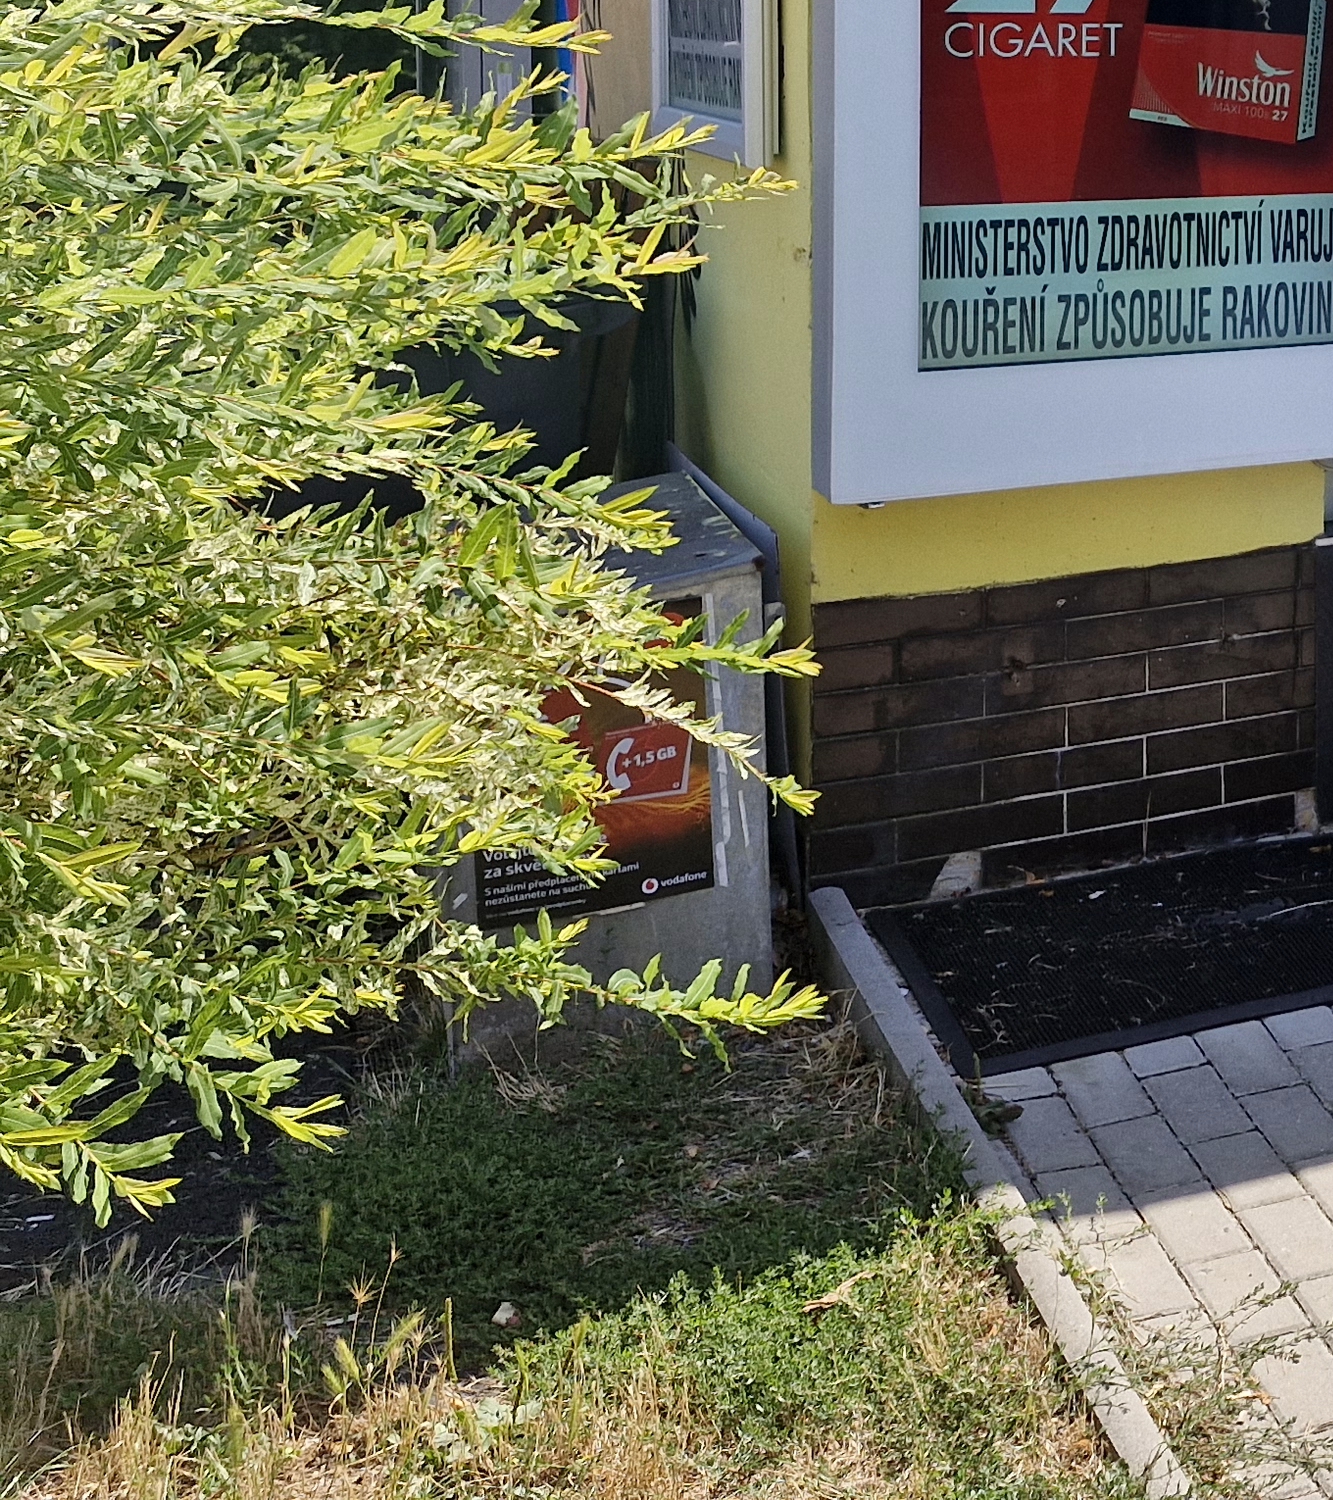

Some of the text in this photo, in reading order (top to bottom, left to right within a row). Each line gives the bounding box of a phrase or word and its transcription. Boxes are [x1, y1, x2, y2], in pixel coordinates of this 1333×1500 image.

[944, 22, 1124, 58] CIGARET
[1197, 62, 1291, 109] Winston
[1272, 110, 1289, 122] 27
[922, 214, 1089, 280] MINISTERSTVO
[1096, 200, 1264, 273] ZDRAVOTNICTVÍ
[922, 284, 1049, 360] KOUŘENÍ
[1056, 278, 1212, 351] ZPŮSOBUJE
[656, 745, 677, 761] GB
[484, 866, 503, 880] za
[661, 870, 708, 888] vodafone
[493, 882, 527, 896] našimi
